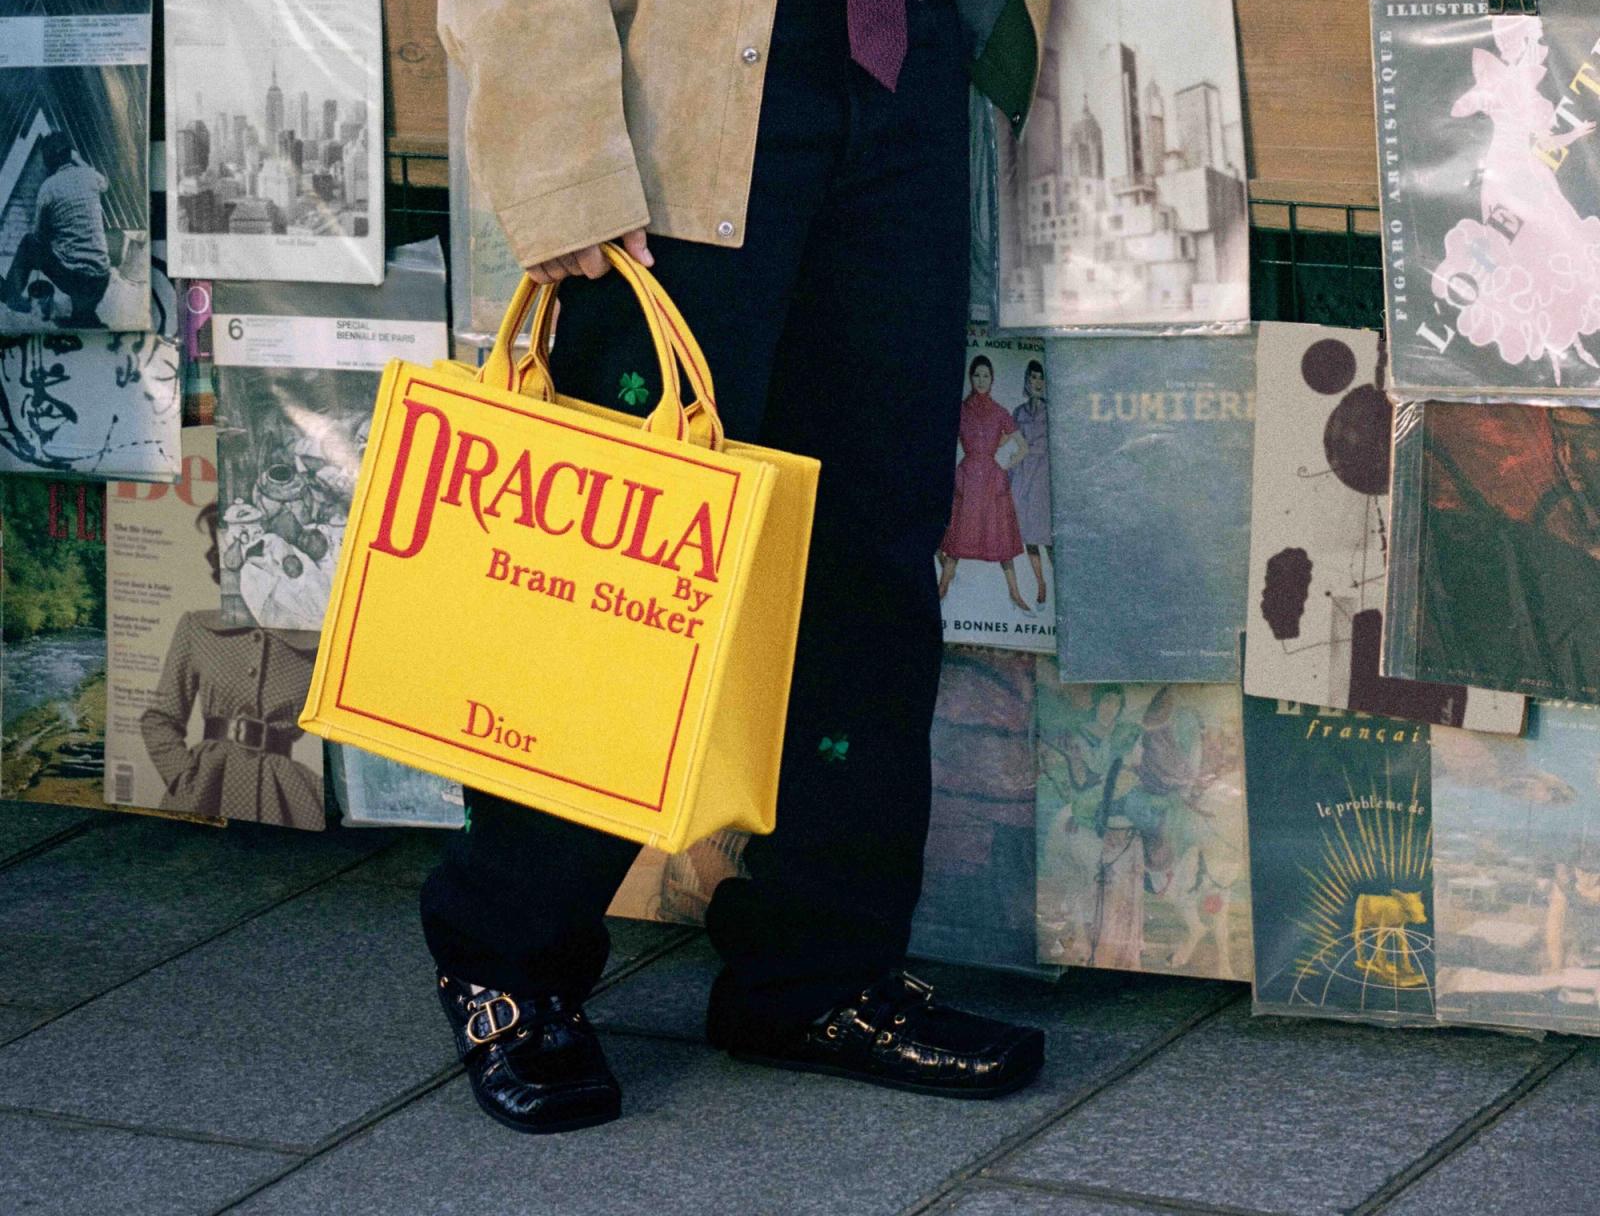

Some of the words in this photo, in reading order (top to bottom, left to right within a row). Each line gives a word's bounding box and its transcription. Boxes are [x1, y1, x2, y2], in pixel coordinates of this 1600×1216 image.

[1380, 30, 1400, 203] ARTISTIQUE
[1390, 219, 1407, 321] FIGARO
[228, 318, 243, 340] 6
[337, 331, 376, 341] BIENNALE
[378, 333, 390, 342] DE
[391, 334, 415, 344] PARIS
[985, 340, 1013, 350] MODE
[368, 397, 718, 582] DRACULA
[486, 548, 576, 602] Bram
[590, 582, 704, 639] Stoker
[672, 576, 713, 612] By
[953, 620, 1009, 633] BONNES
[461, 699, 537, 753] Dior
[1306, 719, 1433, 744] françai
[1316, 802, 1331, 817] le
[1408, 800, 1424, 815] de
